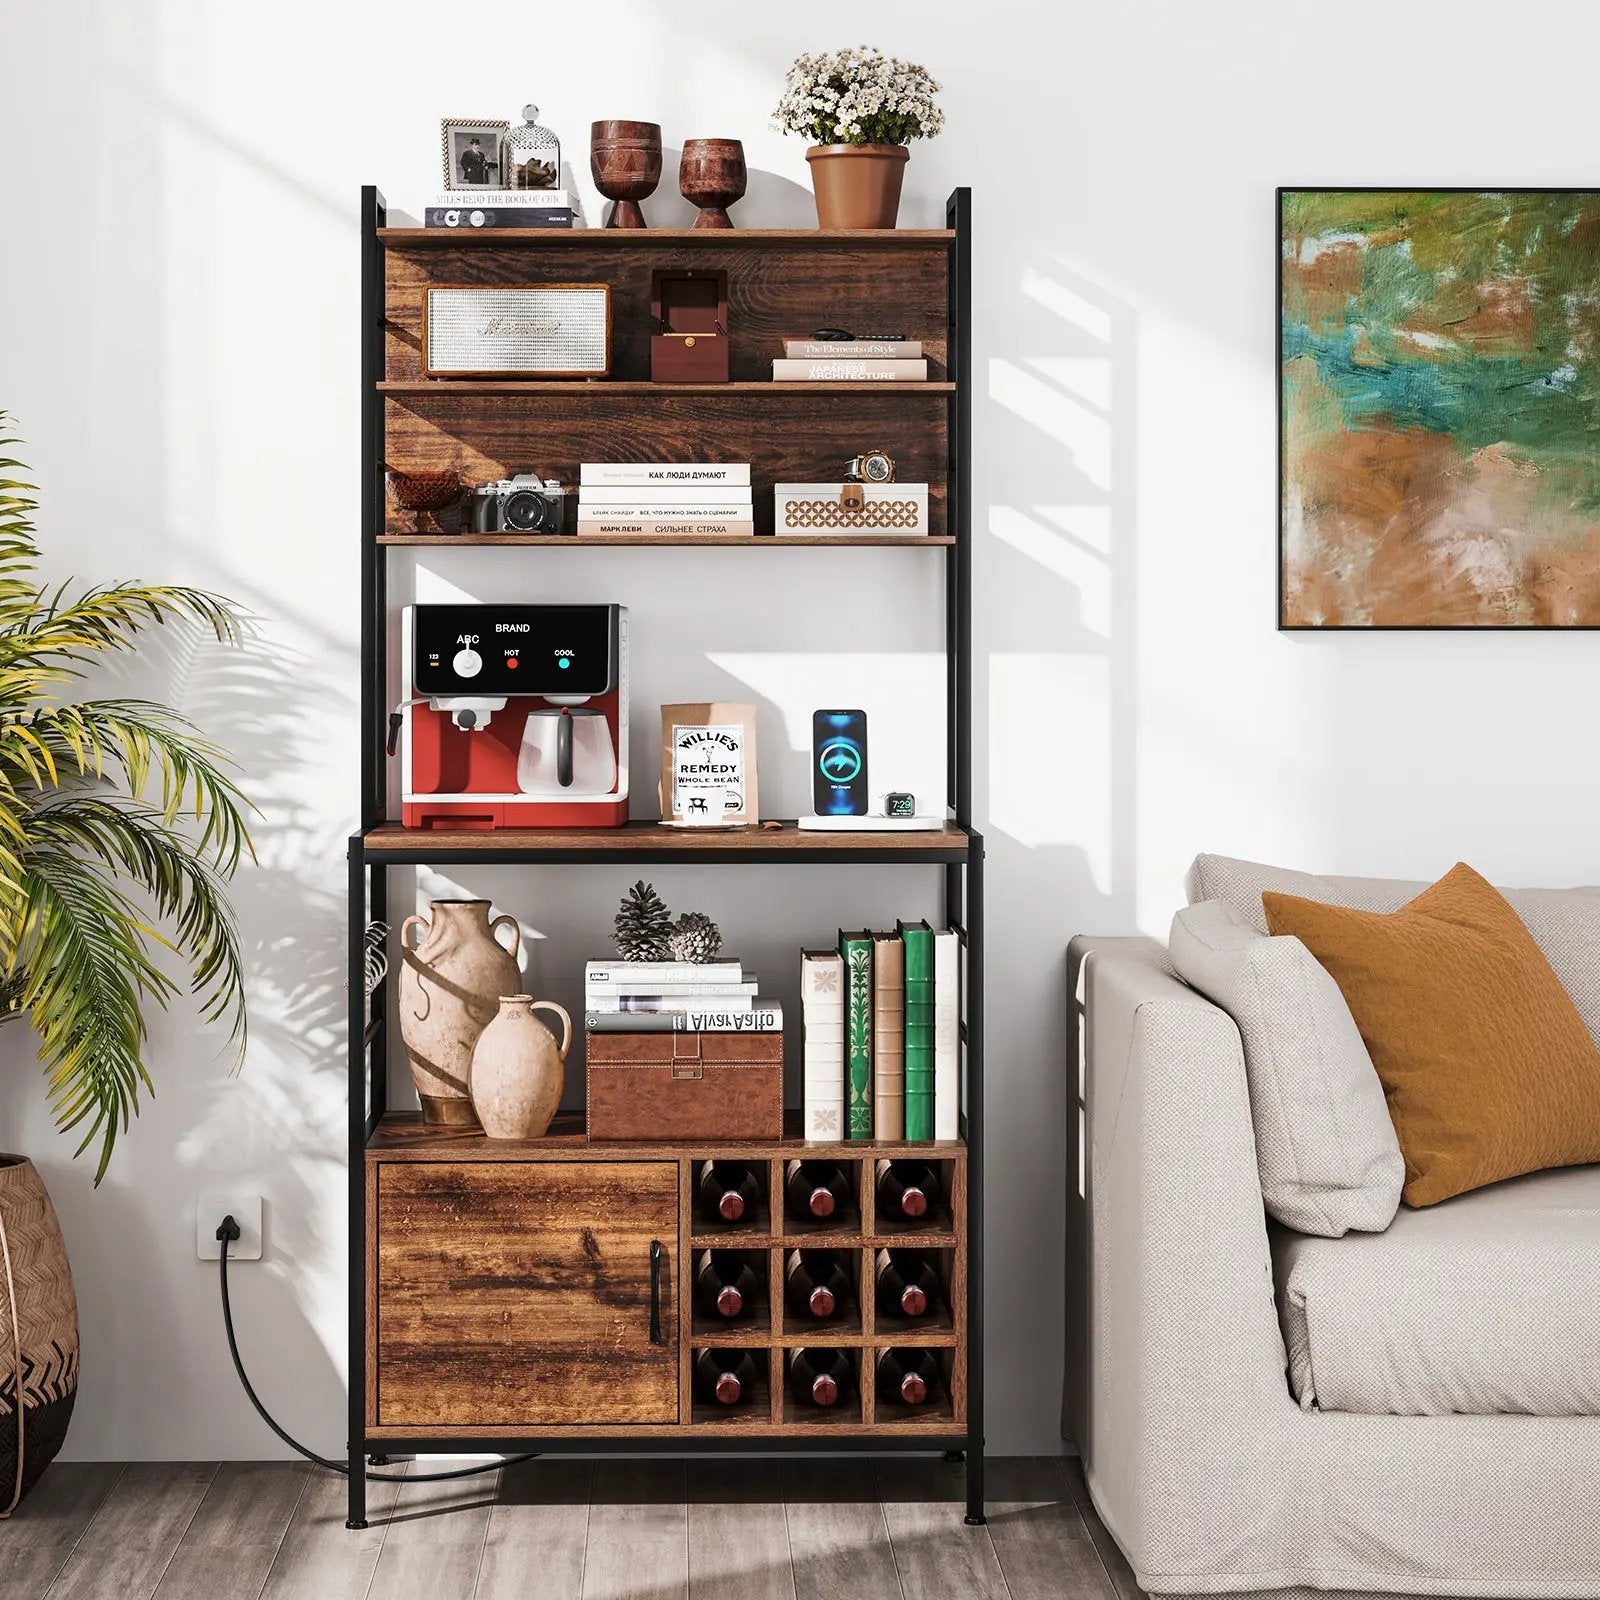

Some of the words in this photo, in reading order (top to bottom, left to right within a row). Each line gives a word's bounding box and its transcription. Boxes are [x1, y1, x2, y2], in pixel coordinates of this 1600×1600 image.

[436, 195, 461, 204] MILES
[463, 195, 485, 204] REDD
[487, 195, 503, 204] THE
[505, 195, 527, 204] BOOK
[529, 195, 540, 204] OF
[804, 344, 821, 353] The
[823, 344, 863, 353] Elements
[863, 344, 873, 353] of
[873, 344, 897, 355] Style
[808, 372, 896, 380] ARCHITECTURE
[648, 471, 664, 480] КАК
[665, 471, 690, 480] ЛЮДИ
[691, 471, 726, 480] ДУМАЮТ
[600, 525, 621, 533] МАРК
[621, 525, 642, 533] ЛЕВИ
[655, 525, 693, 533] СИЛЬНЕЕ
[696, 525, 727, 533] СТРАХА
[495, 623, 531, 633] BRAND
[456, 634, 480, 645] ABC
[504, 649, 520, 657] HOT
[554, 649, 575, 657] COOL
[678, 731, 739, 752] WILLIE'S
[680, 764, 737, 774] REMEDY
[892, 800, 911, 809] 7:29
